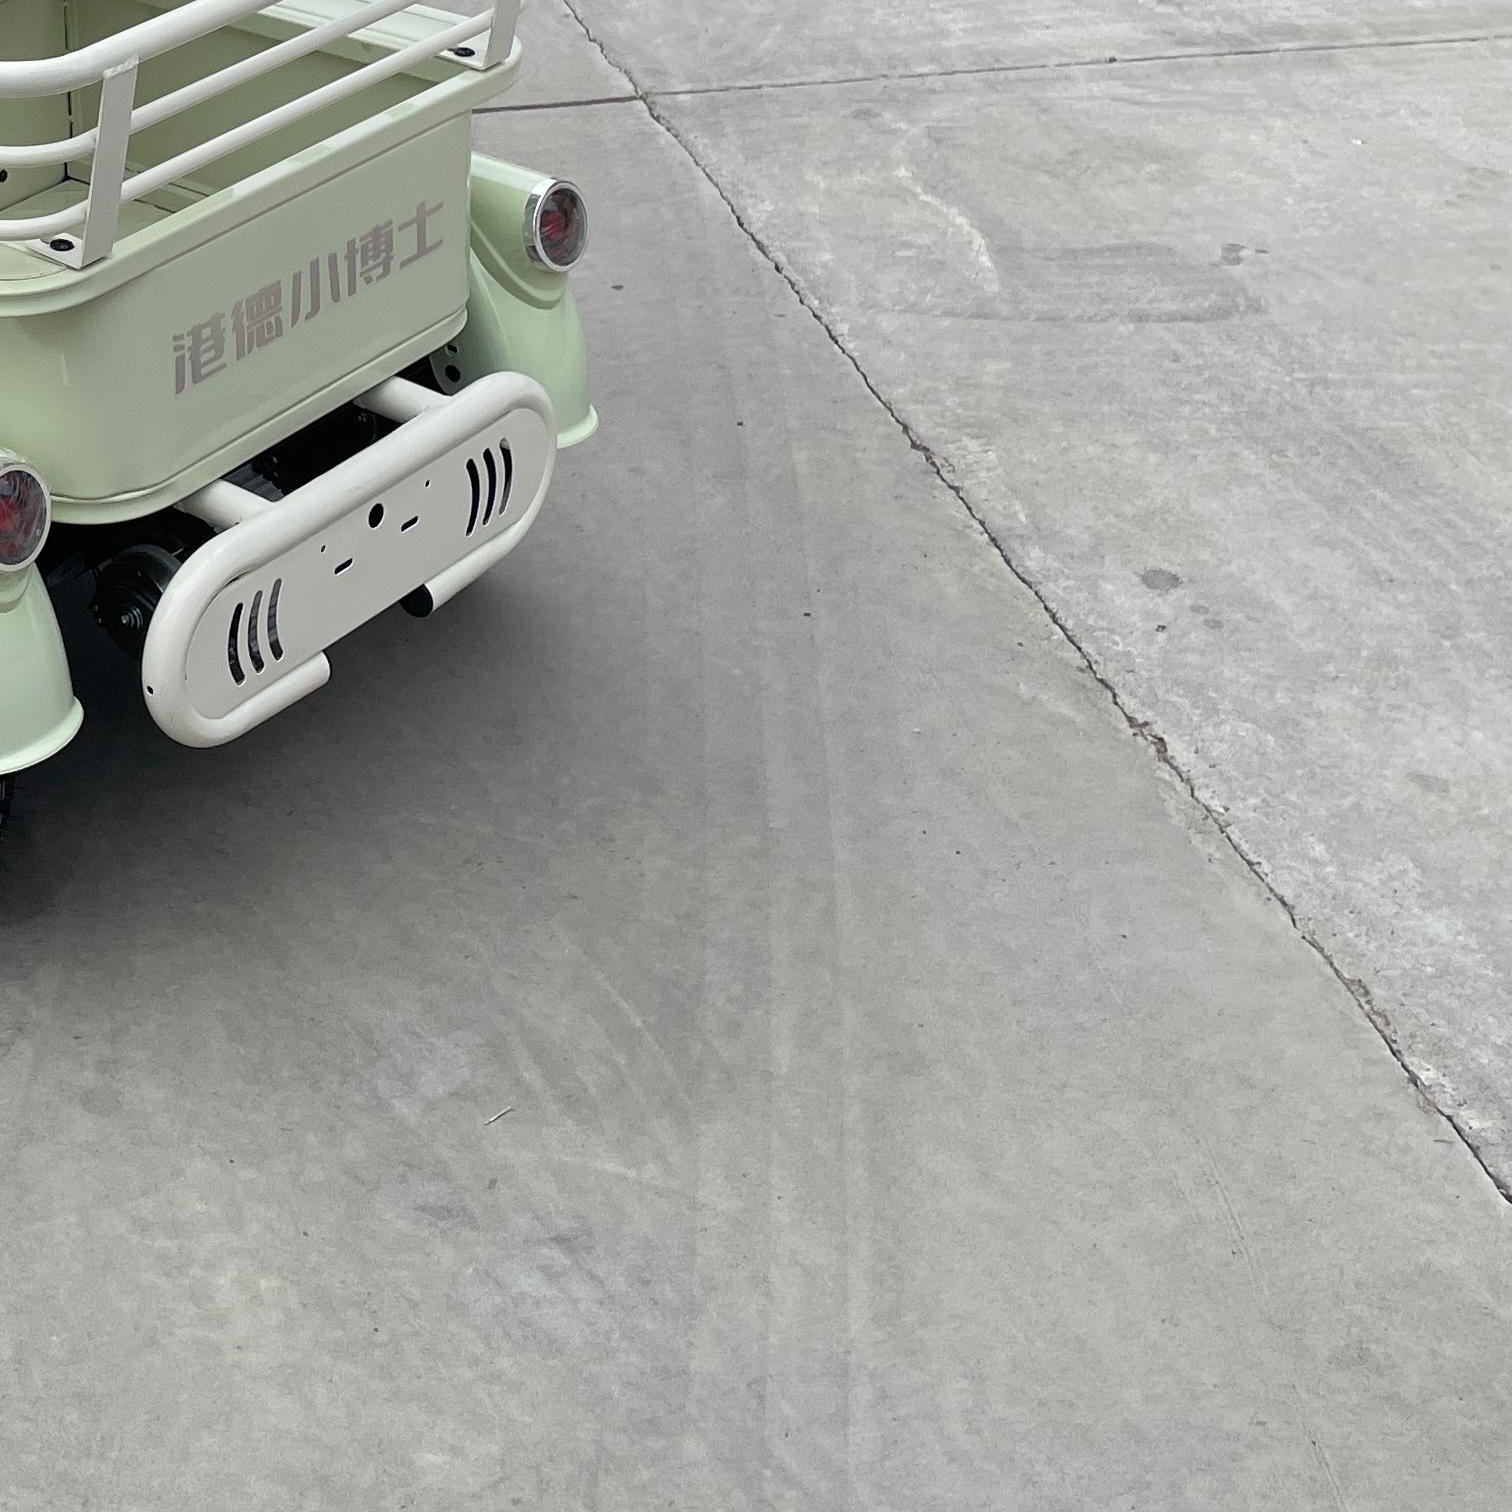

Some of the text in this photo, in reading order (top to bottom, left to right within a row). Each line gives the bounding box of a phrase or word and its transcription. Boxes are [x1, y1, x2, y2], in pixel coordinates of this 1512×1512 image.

[172, 201, 444, 395] 港德小博士
